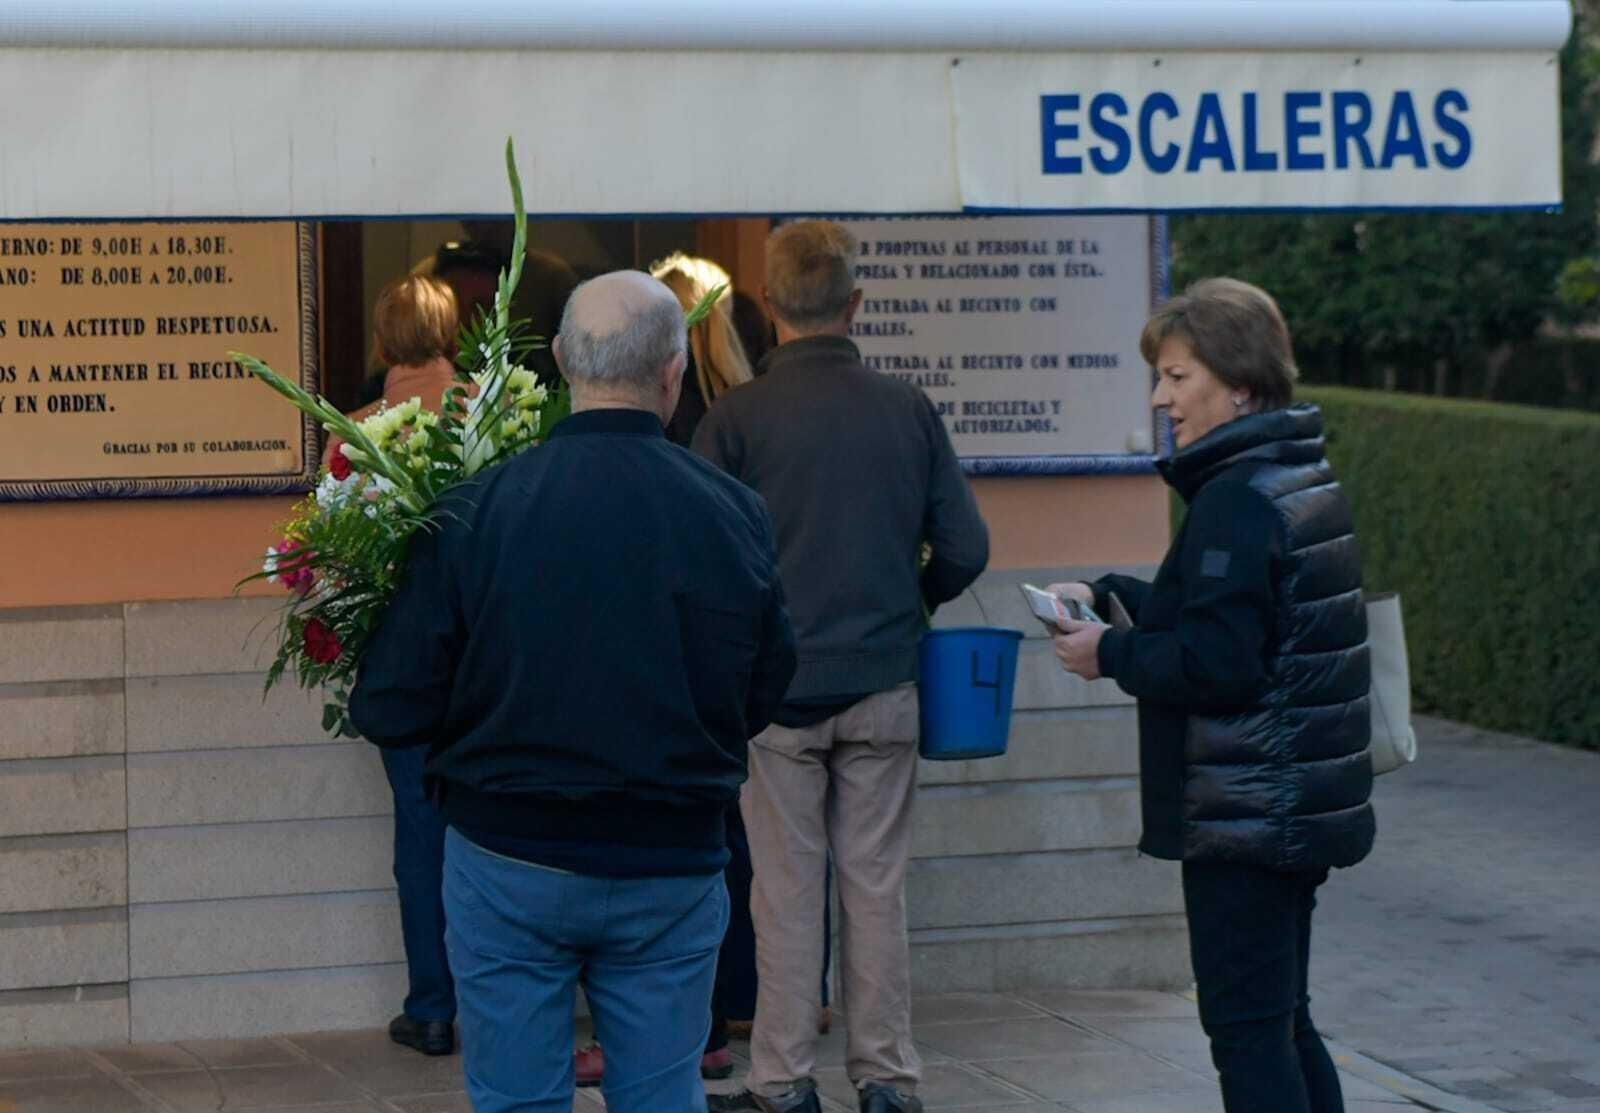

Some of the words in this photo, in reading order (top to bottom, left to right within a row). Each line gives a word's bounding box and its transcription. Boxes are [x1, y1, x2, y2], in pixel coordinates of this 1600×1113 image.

[1040, 89, 1472, 174] ESCALERAS
[60, 237, 82, 256] DE
[92, 236, 142, 257] 9,00H
[149, 242, 160, 256] A
[167, 236, 233, 256] 18,30H.
[875, 240, 946, 256] PROPINAS
[954, 241, 970, 256] AL
[977, 240, 1047, 256] PERSONAL
[1056, 240, 1073, 255] DE
[1080, 240, 1099, 255] LA
[61, 267, 84, 285] DE
[91, 266, 142, 286] 8,00H
[149, 271, 160, 285] A
[167, 265, 233, 285] 20,00H.
[903, 263, 914, 279] Y
[920, 263, 1020, 279] RELACIONADO
[1028, 263, 1056, 278] CON
[863, 298, 929, 314] ENTRADA
[936, 298, 953, 313] AL
[959, 298, 1021, 313] RECINTO
[1029, 297, 1057, 312] CON
[17, 319, 55, 338] UNA
[63, 317, 145, 337] ACTITUD
[156, 315, 278, 335] RESPETUOSA.
[862, 355, 930, 371] ENTRADA
[936, 356, 954, 370] AL
[961, 354, 1023, 370] RECINTO
[1030, 354, 1059, 369] CON
[1066, 353, 1119, 368] MEDIOS
[27, 365, 40, 383] A
[48, 363, 148, 383] MANTENER
[157, 363, 178, 381] EL
[15, 395, 37, 413] EN
[47, 393, 115, 413] ORDEN.
[962, 400, 1046, 417] BICICLETAS
[1049, 399, 1062, 415] Y
[952, 419, 1057, 434] AUTORIZADOS.
[102, 442, 151, 455] GRACIAS
[156, 442, 178, 454] POR
[183, 441, 196, 453] SU
[971, 650, 1004, 717] 4
